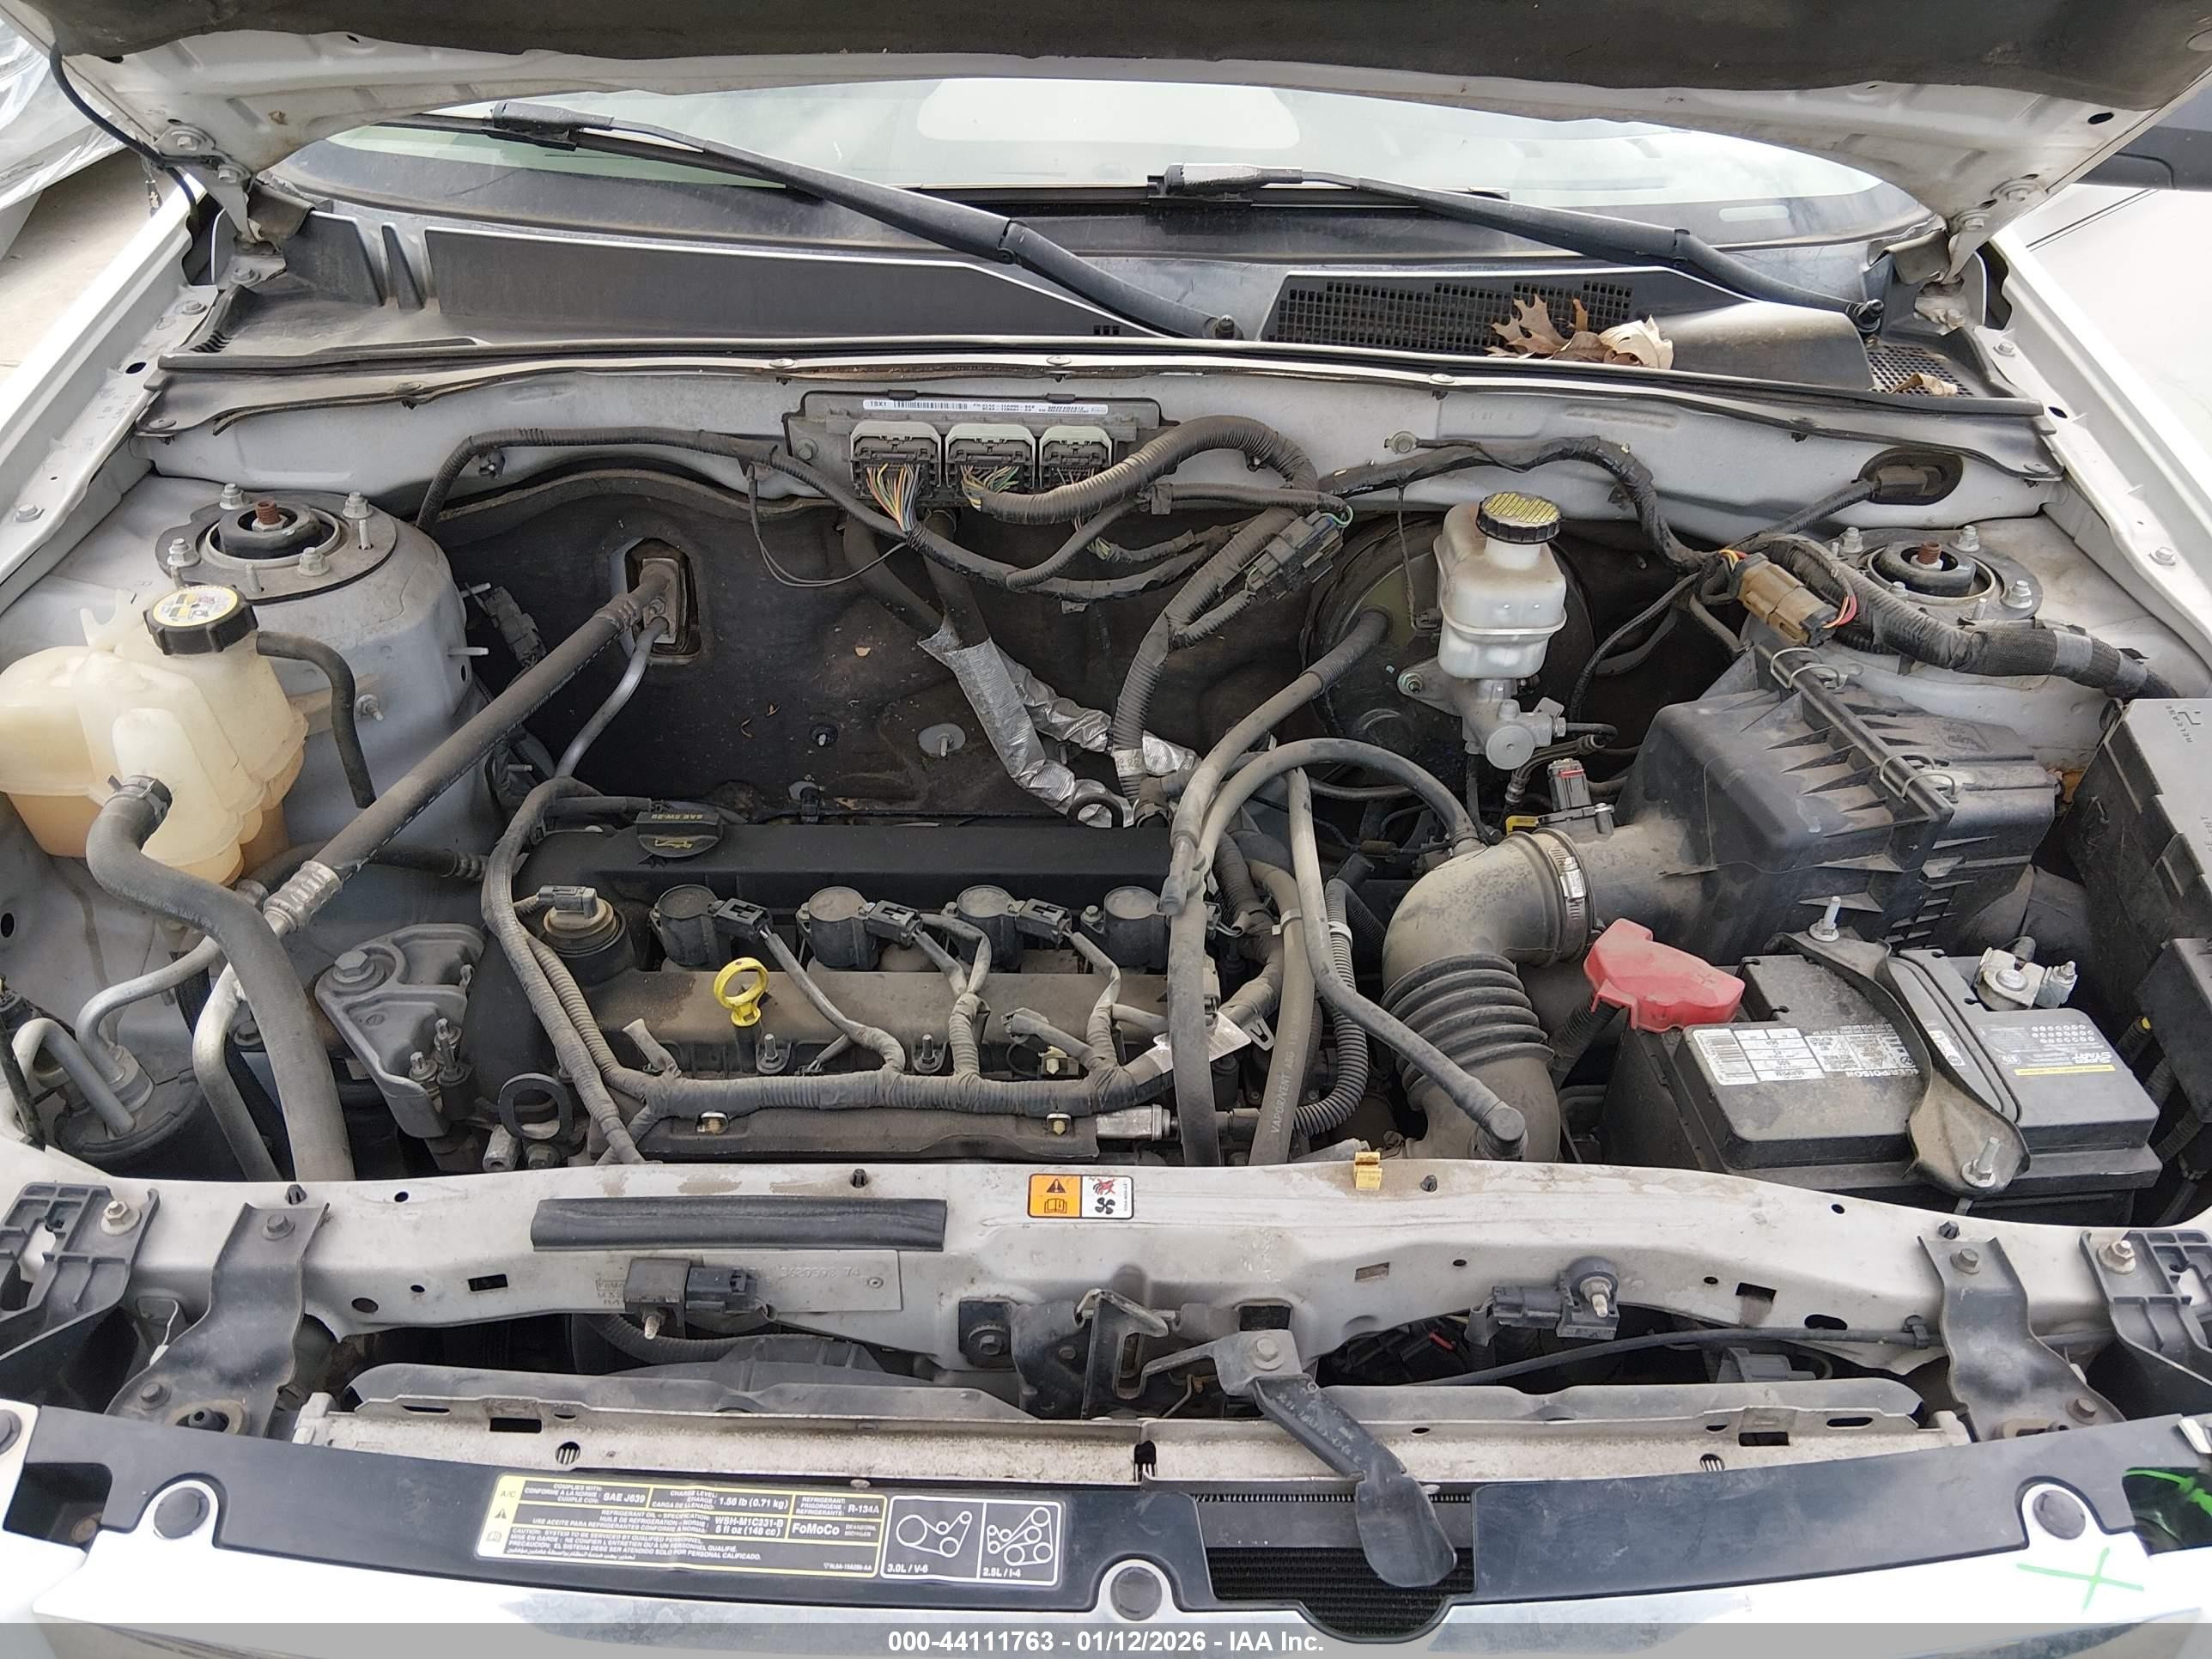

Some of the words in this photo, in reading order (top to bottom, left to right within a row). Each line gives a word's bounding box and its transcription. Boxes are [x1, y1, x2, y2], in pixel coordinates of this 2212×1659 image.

[603, 1492, 623, 1502] SAE
[623, 1493, 646, 1504] J639
[848, 1504, 880, 1514] R-134A
[791, 1522, 840, 1535] FoMoCo
[887, 1563, 907, 1572] 3.0L
[982, 1567, 1002, 1577] 2.5L
